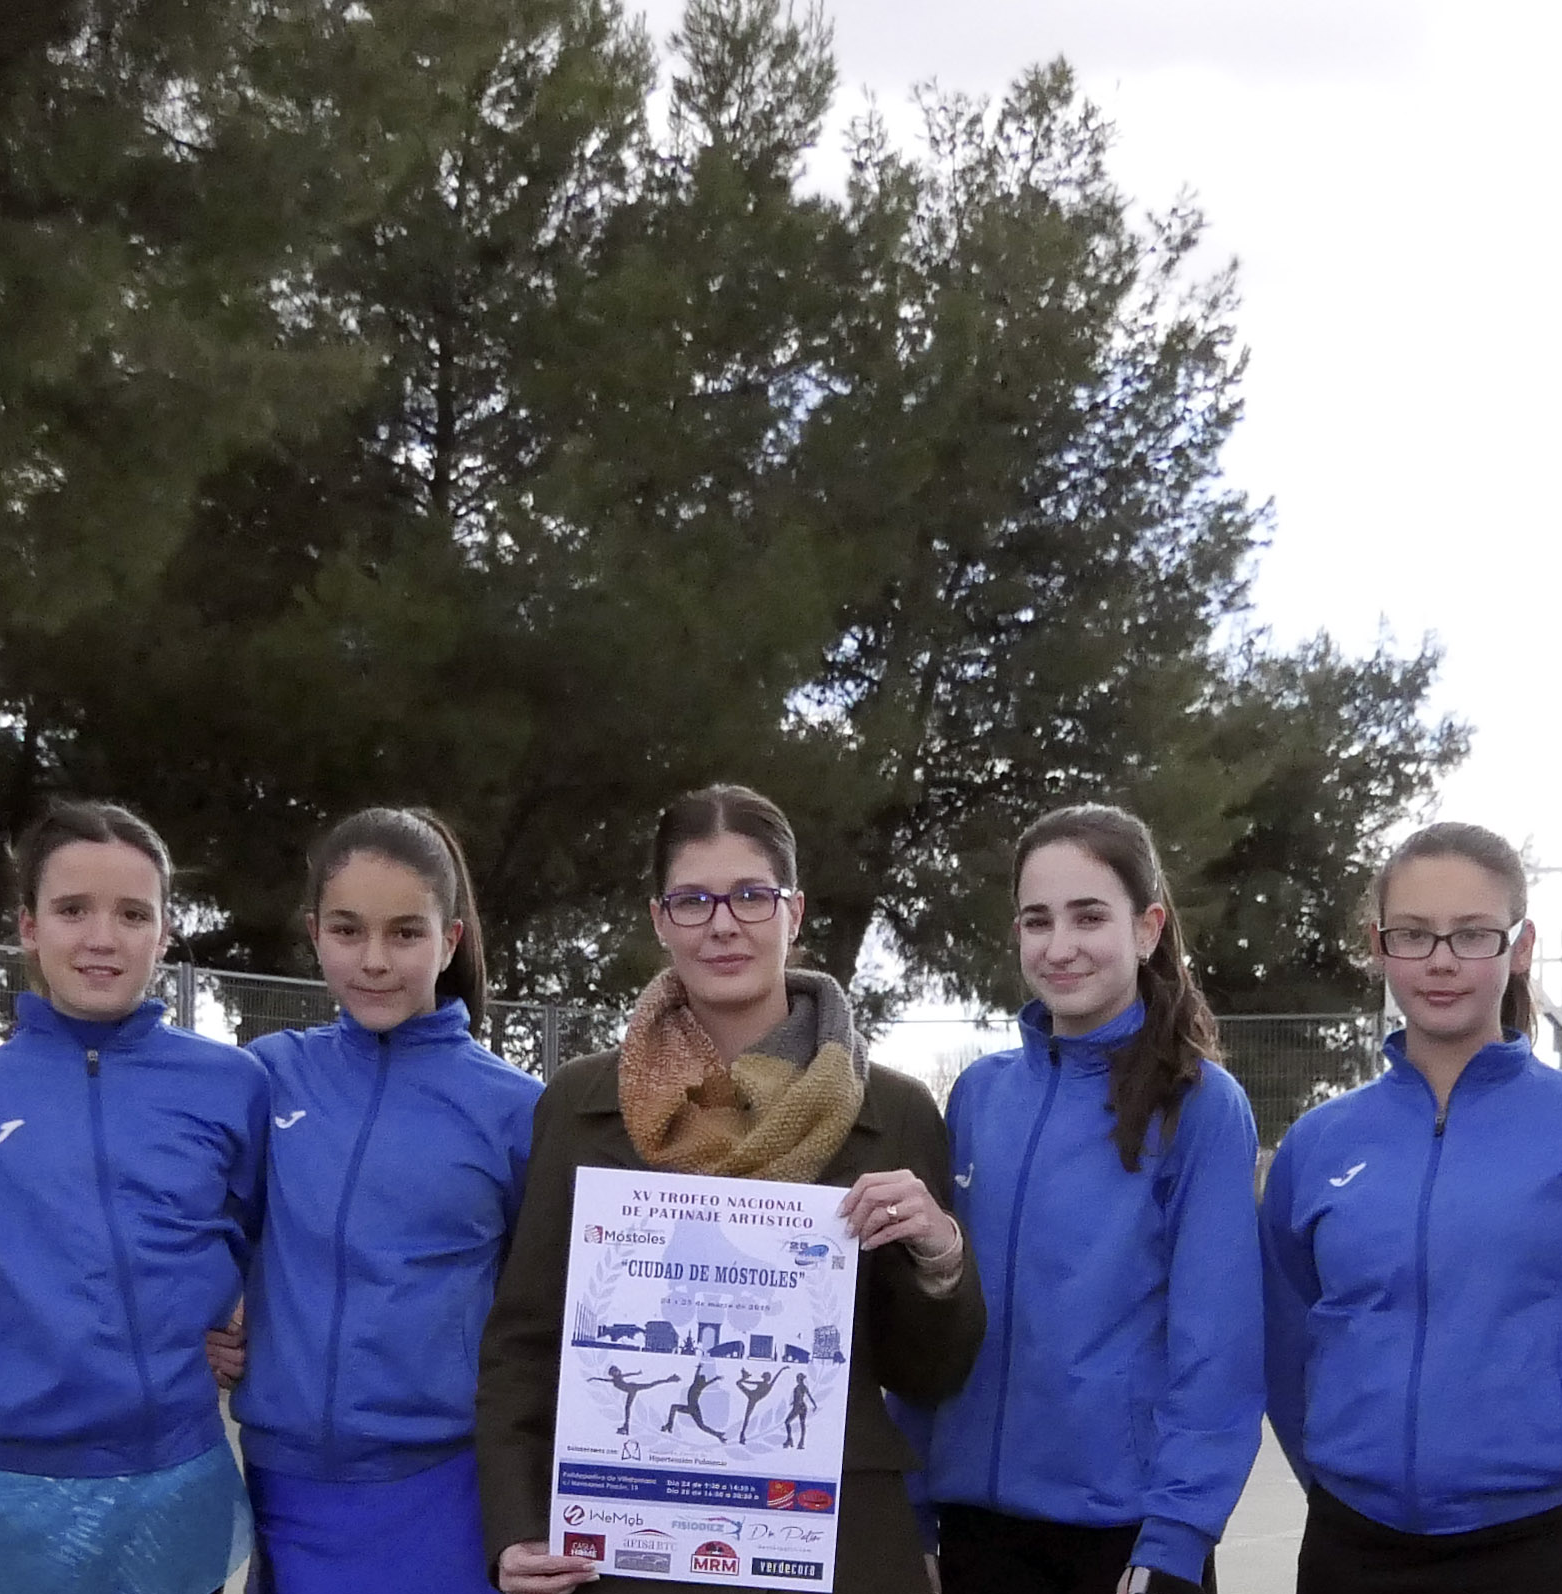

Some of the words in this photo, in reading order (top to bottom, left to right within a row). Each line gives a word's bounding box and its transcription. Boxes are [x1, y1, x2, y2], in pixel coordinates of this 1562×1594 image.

[632, 1190, 651, 1202] XV
[660, 1191, 720, 1206] TROFEO
[727, 1196, 804, 1213] NACIONAL
[622, 1205, 642, 1218] DE
[650, 1207, 721, 1223] PATINAJE
[728, 1211, 814, 1229] ARTÍSTICO
[604, 1229, 666, 1246] Móstoles
[689, 1264, 710, 1283] DE
[589, 1510, 644, 1527] WeMob
[693, 1557, 737, 1573] MRM
[759, 1559, 816, 1577] verdecora
